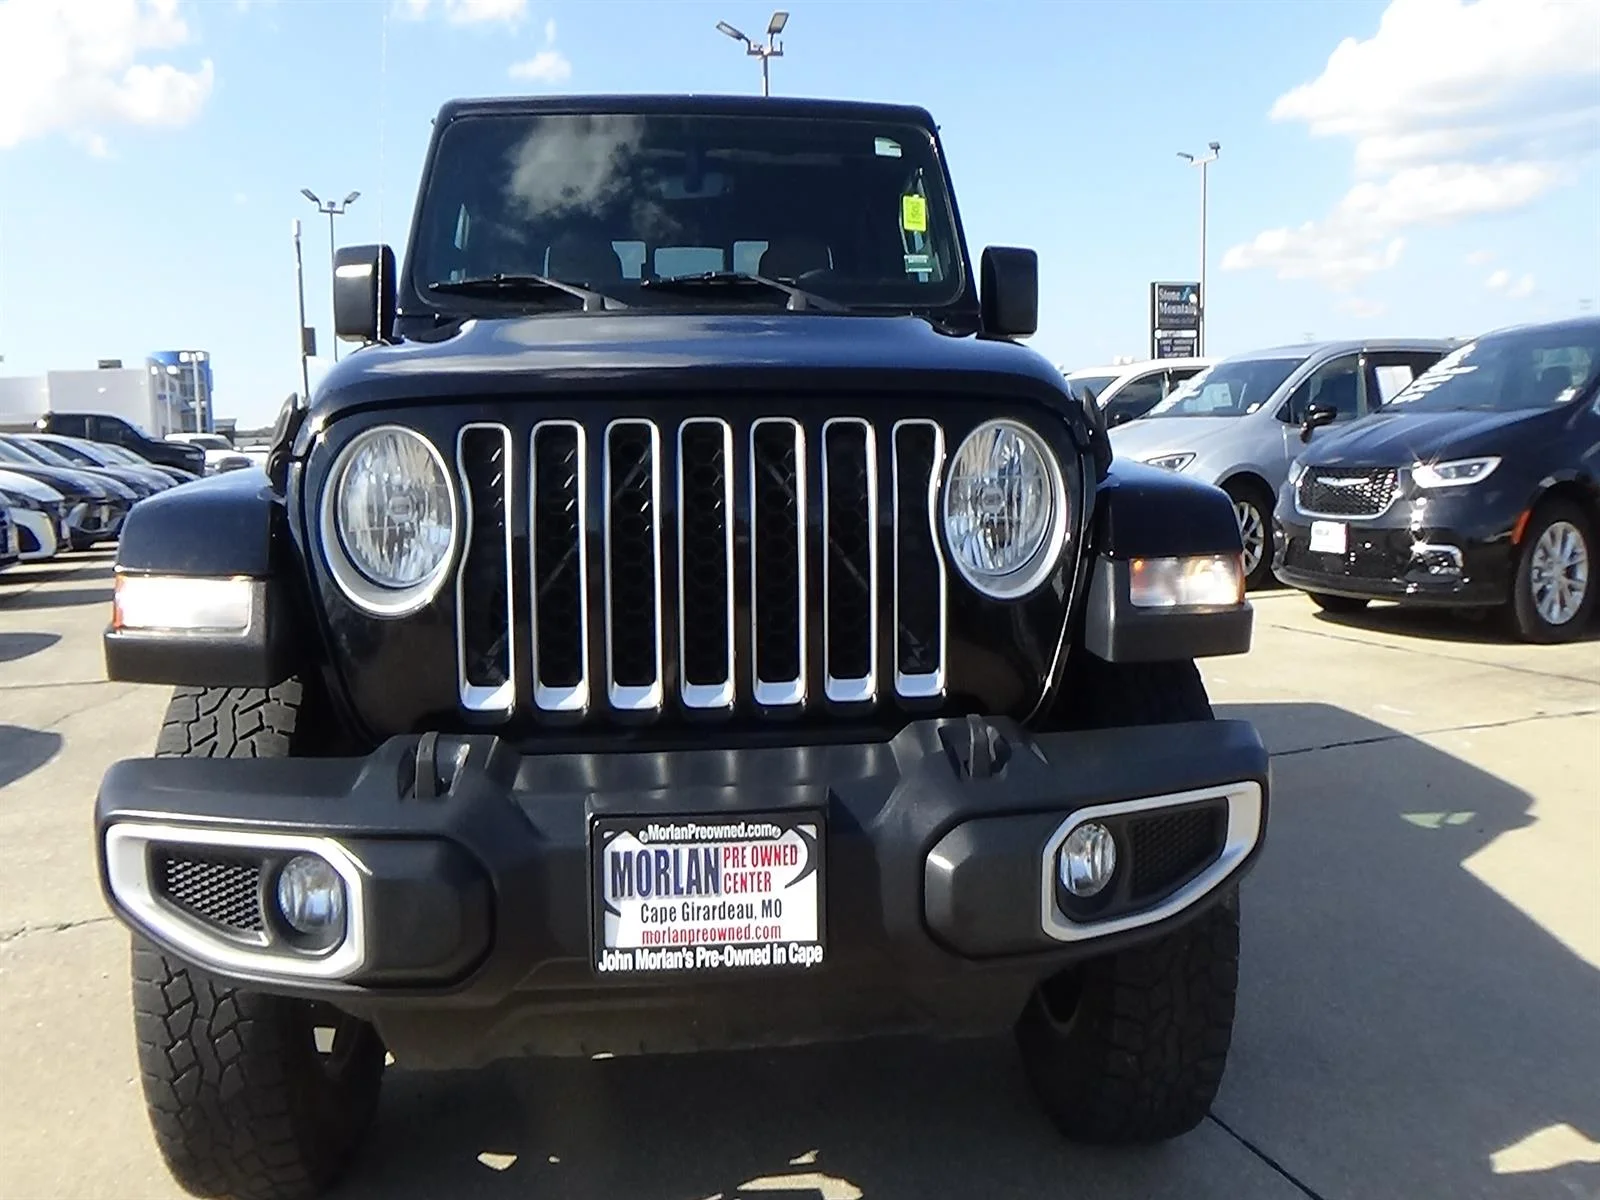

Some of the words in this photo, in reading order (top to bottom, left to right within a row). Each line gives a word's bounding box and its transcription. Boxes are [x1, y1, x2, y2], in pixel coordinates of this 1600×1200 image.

[1159, 302, 1197, 315] Mountain
[647, 822, 772, 841] MorlanPreowned.com
[723, 846, 747, 868] PRE
[751, 844, 798, 866] OWNED
[611, 847, 719, 897] MORLAN
[723, 871, 772, 894] CENTER
[640, 902, 677, 925] Cape
[681, 900, 757, 921] Girardeau,
[761, 898, 783, 918] MO
[642, 924, 782, 945] morlanpreowned.com
[598, 950, 633, 972] John
[635, 947, 694, 969] Morlan's
[696, 944, 771, 967] Pre-Owned
[773, 942, 786, 963] in
[788, 943, 823, 967] Cape
